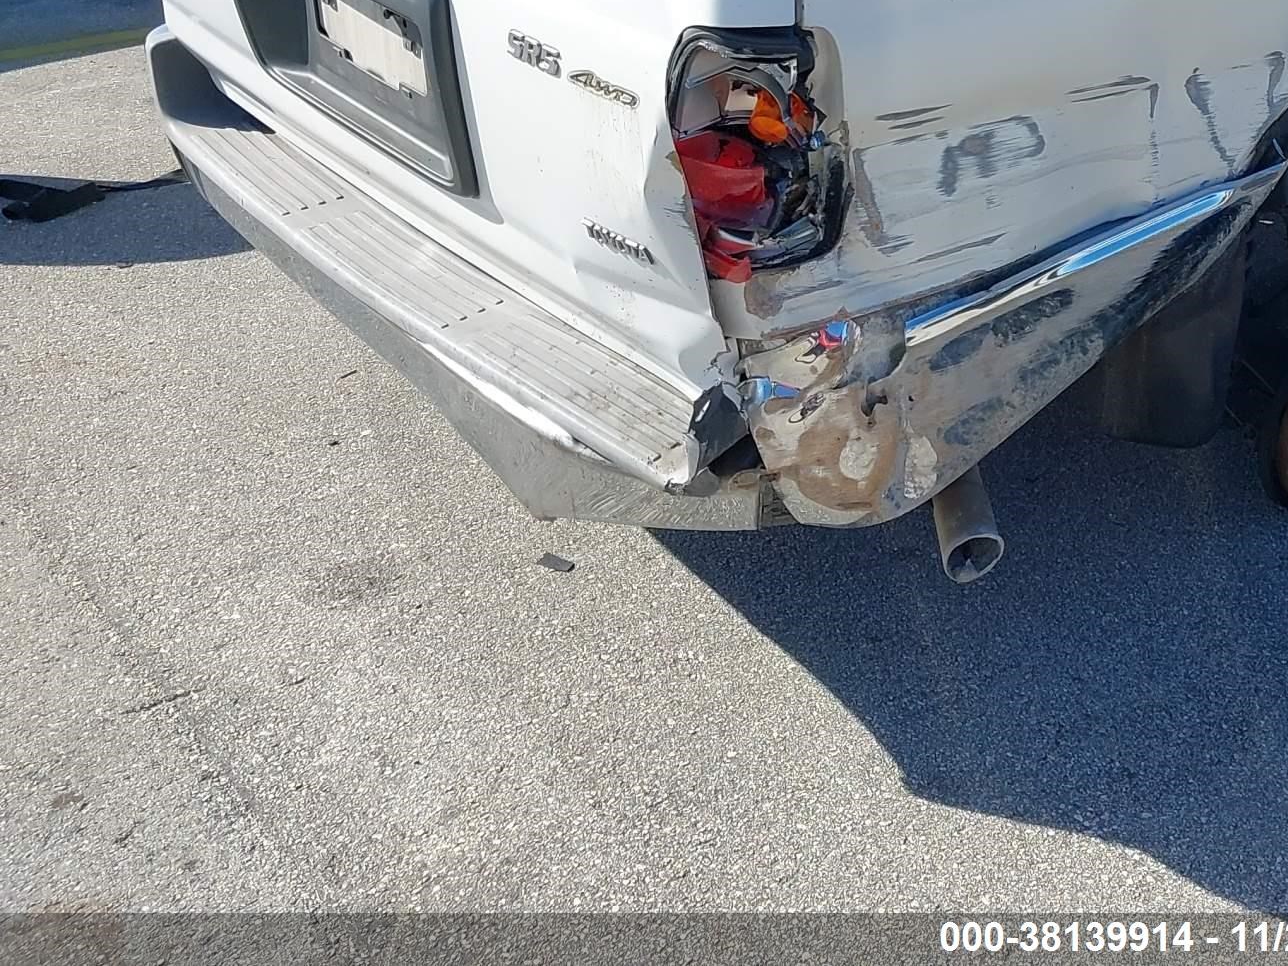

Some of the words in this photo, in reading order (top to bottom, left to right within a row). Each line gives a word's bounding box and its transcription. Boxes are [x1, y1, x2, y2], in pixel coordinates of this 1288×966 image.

[507, 28, 563, 79] SR5
[566, 69, 641, 109] 4WD
[581, 216, 655, 265] TOYOTA
